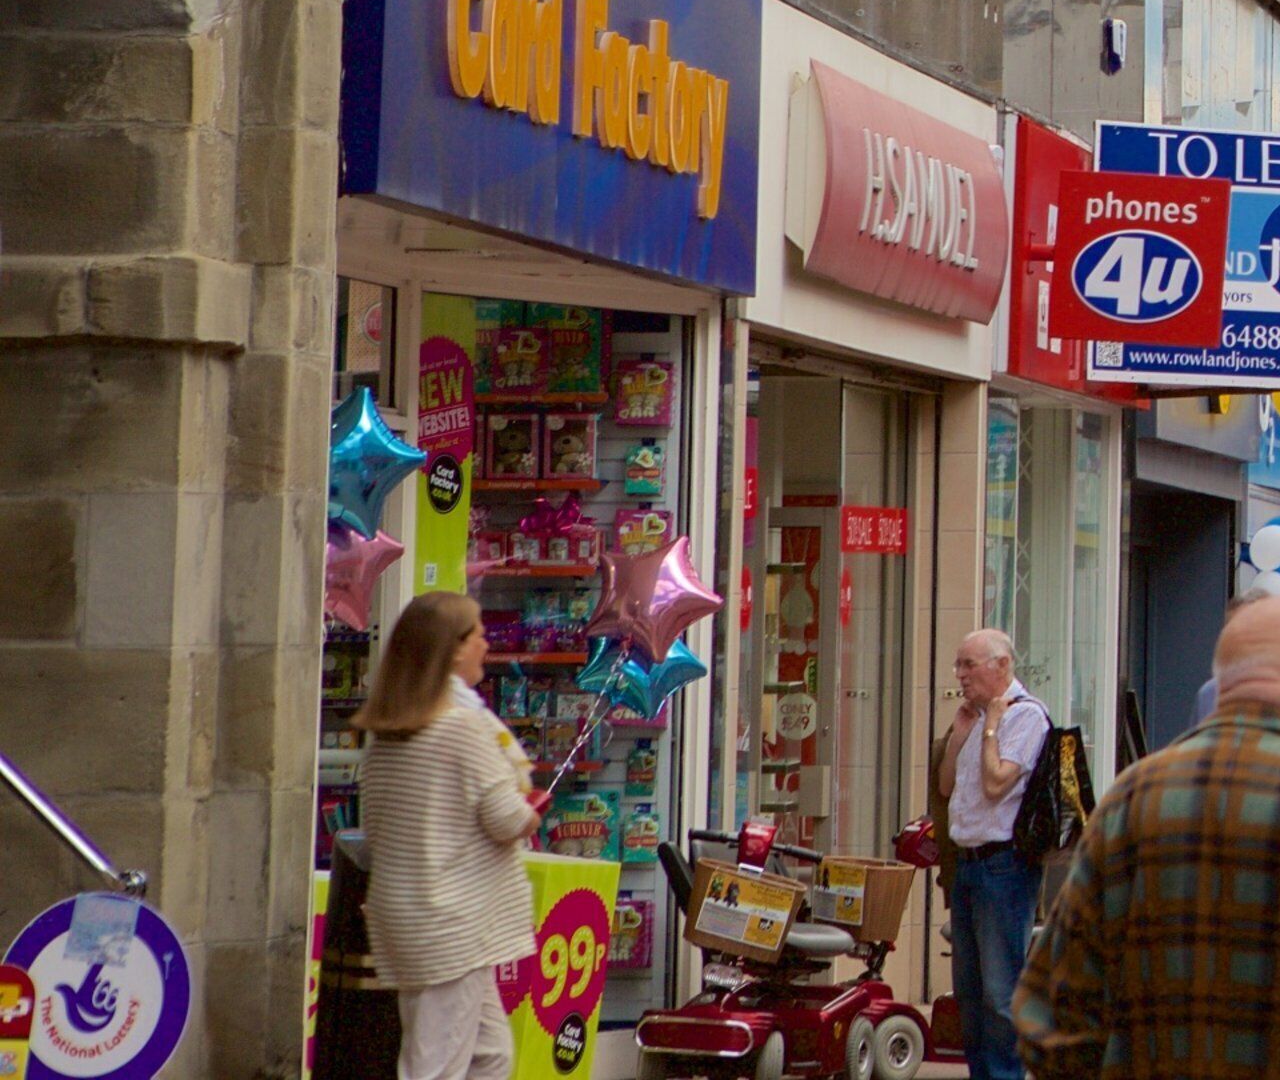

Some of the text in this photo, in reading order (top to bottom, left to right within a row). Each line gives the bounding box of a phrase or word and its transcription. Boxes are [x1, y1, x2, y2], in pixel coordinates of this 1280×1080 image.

[1148, 132, 1218, 180] TO
[1085, 191, 1198, 225] phones
[41, 996, 142, 1059] The National Lottery
